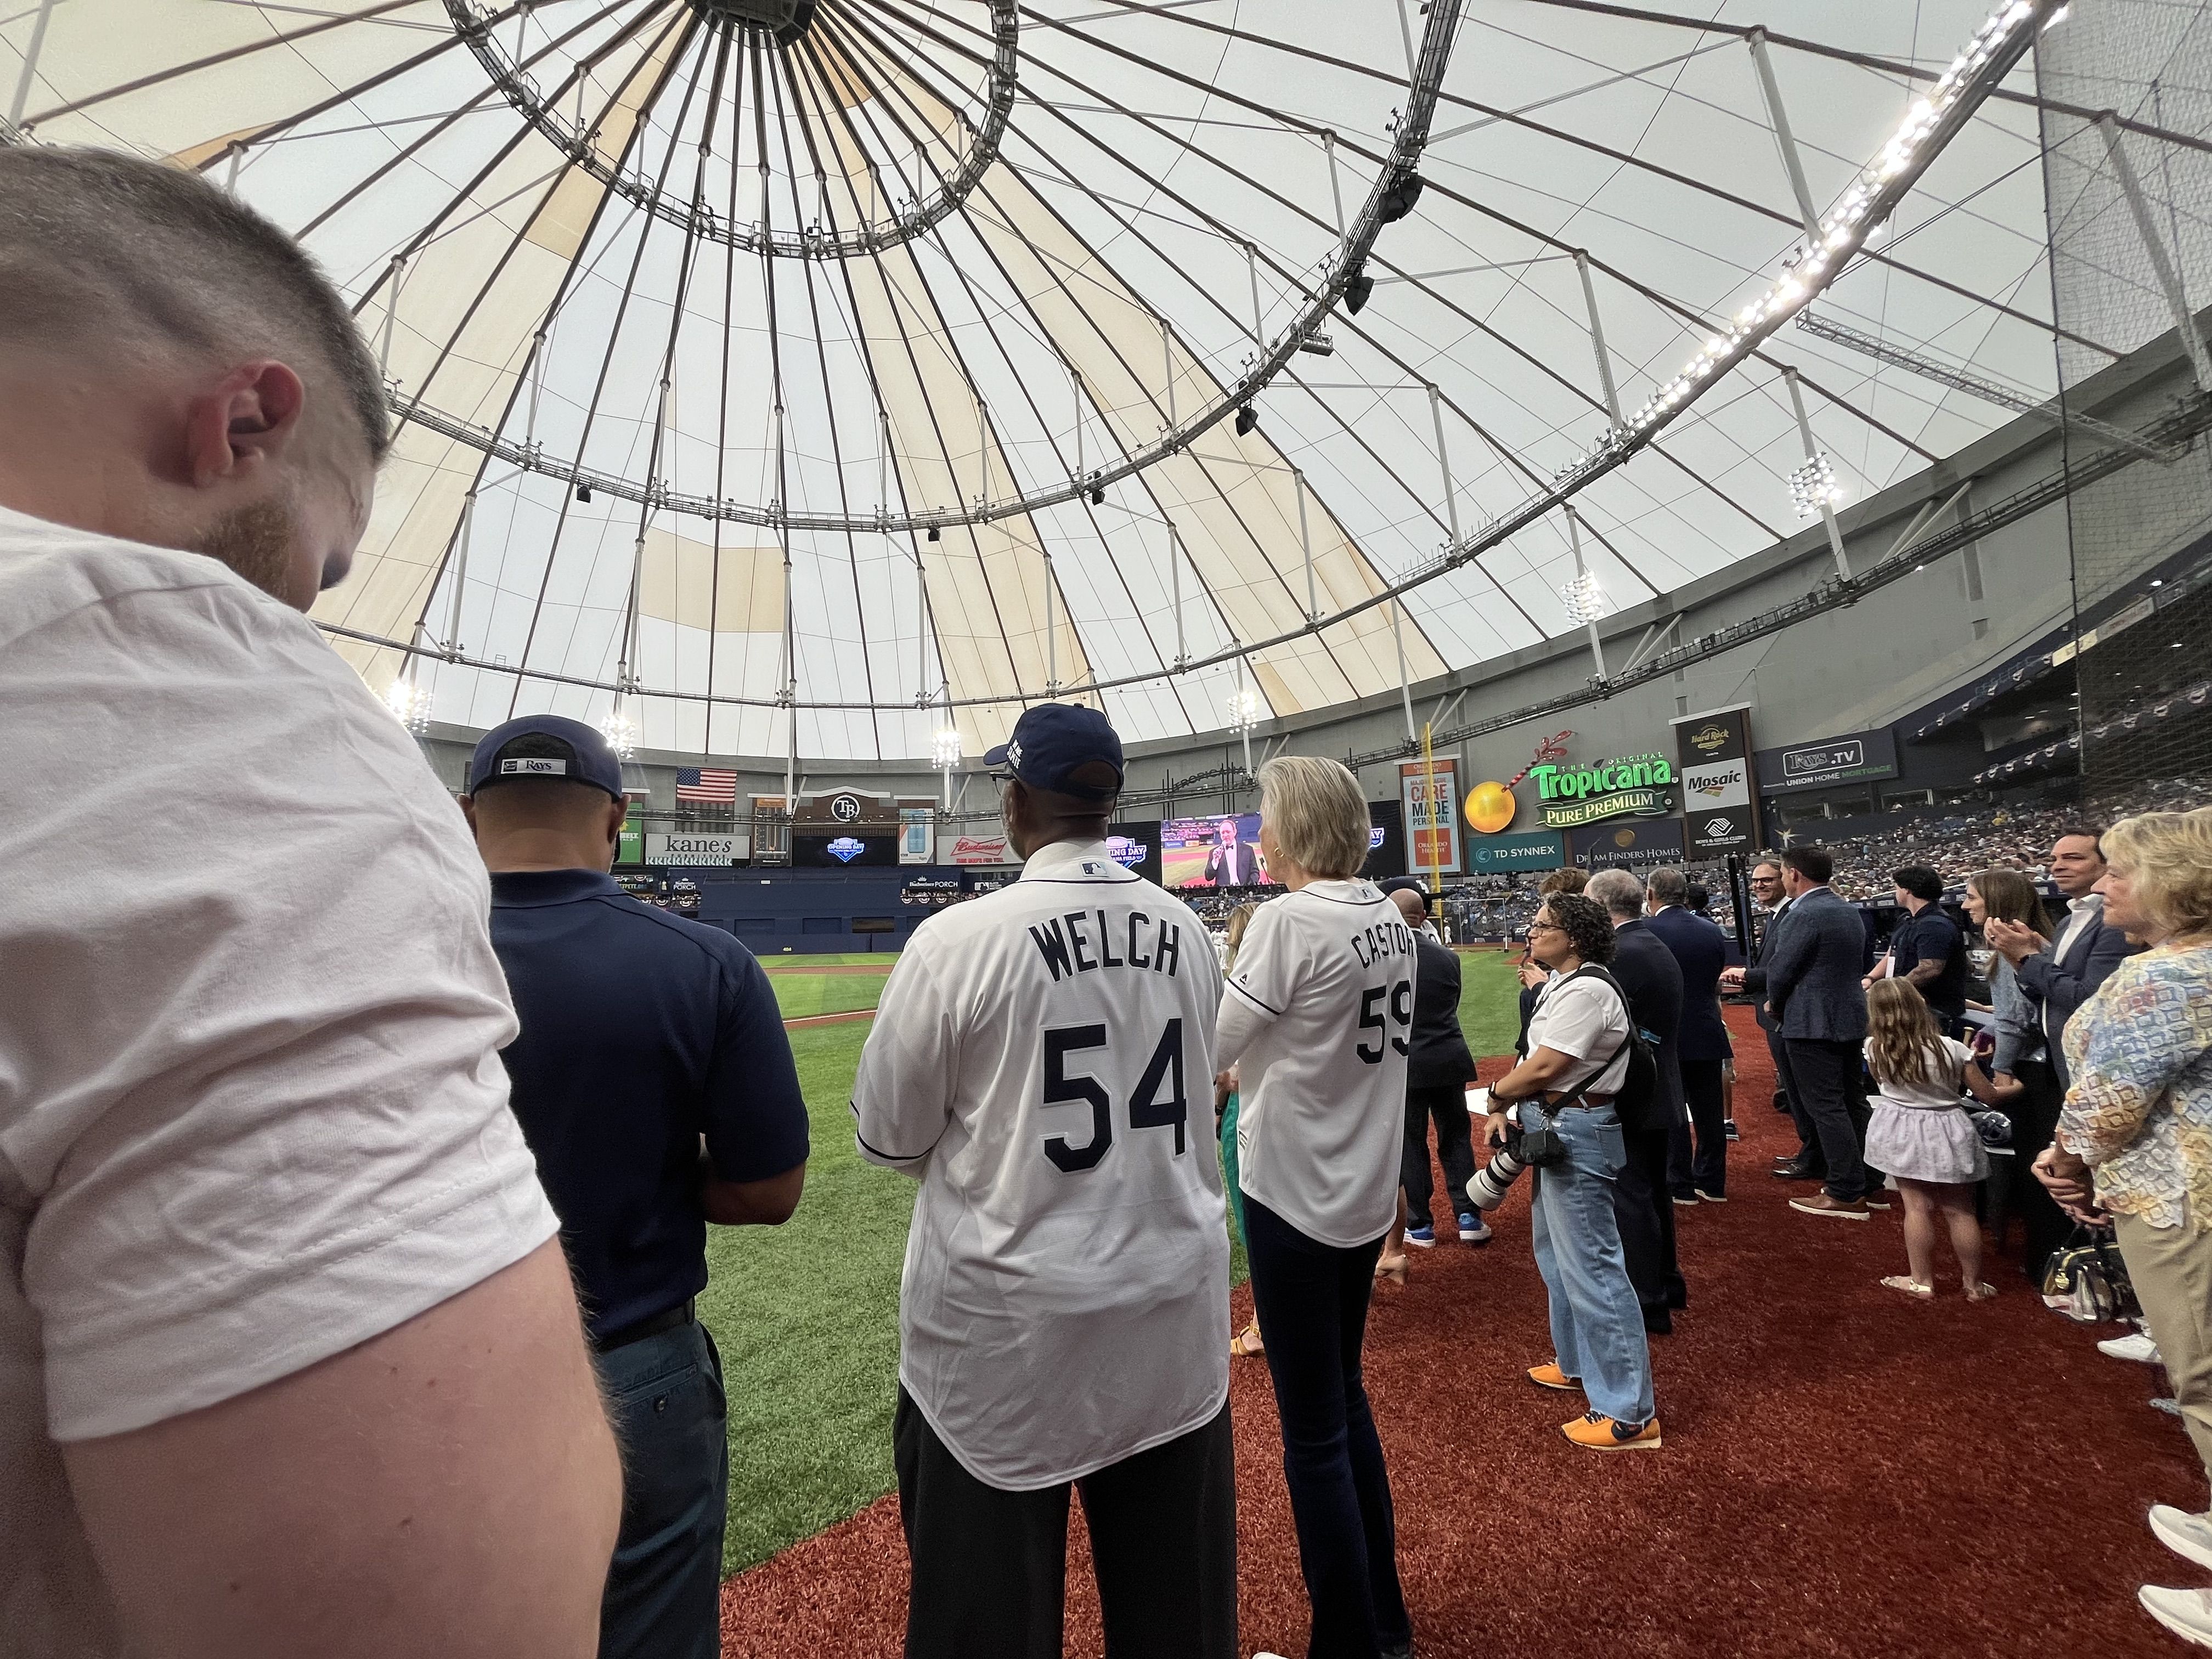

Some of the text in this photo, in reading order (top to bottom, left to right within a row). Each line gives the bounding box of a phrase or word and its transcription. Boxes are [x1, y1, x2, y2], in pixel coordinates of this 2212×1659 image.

[1691, 729, 1729, 743] Hard Rock
[1562, 752, 1663, 772] THE ORIGINAL
[1530, 759, 1671, 799] Tropicana
[1688, 770, 1741, 789] Mosaic
[1786, 776, 1813, 786] UNION
[1814, 772, 1840, 782] HOME
[1841, 764, 1892, 777] MORTGAGE
[1412, 800, 1449, 816] MADE
[1547, 793, 1654, 823] PURE PREMIUM
[665, 836, 732, 853] kane's
[1127, 847, 1144, 855] DAY
[1494, 845, 1555, 858] TD SYNNEX
[1609, 850, 1645, 861] FINDERS
[1647, 848, 1680, 858] HOMES
[1028, 909, 1179, 983] WELCH
[1356, 980, 1411, 1064] 59
[1043, 1018, 1187, 1173] 54
